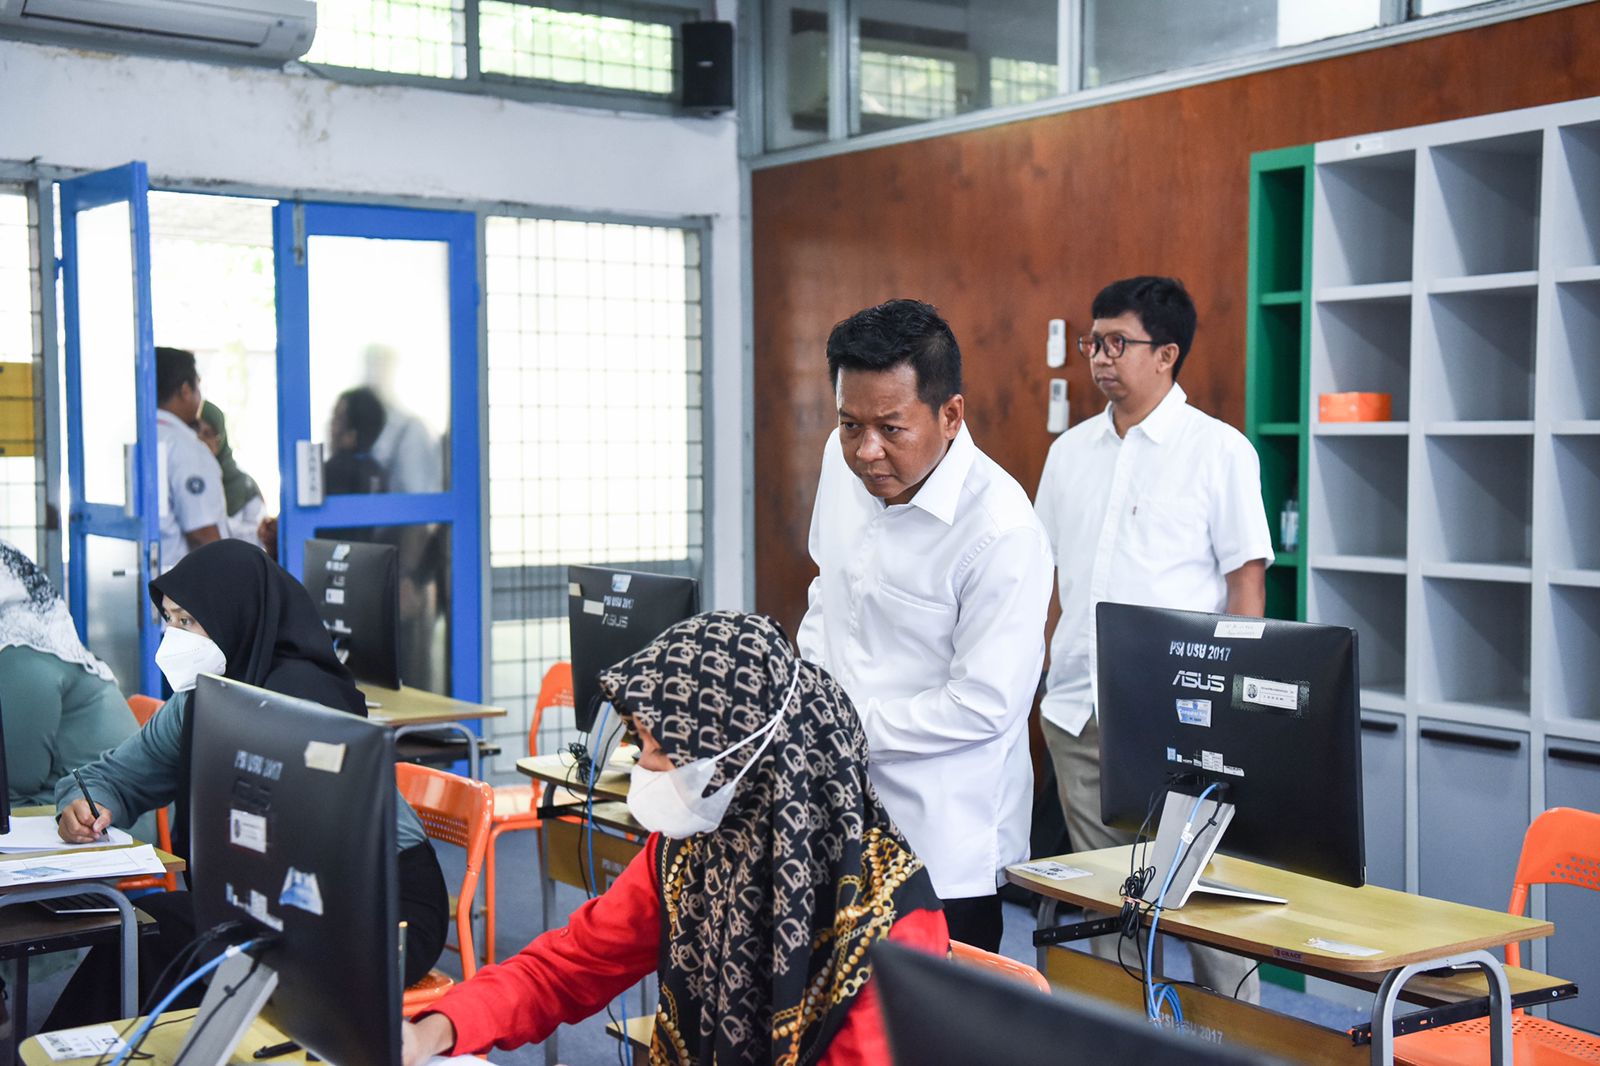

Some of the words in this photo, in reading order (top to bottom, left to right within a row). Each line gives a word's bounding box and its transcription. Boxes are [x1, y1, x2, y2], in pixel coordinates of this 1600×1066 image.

[1169, 641, 1185, 657] PSI
[1207, 645, 1231, 661] 2017
[1172, 670, 1226, 692] ASUS
